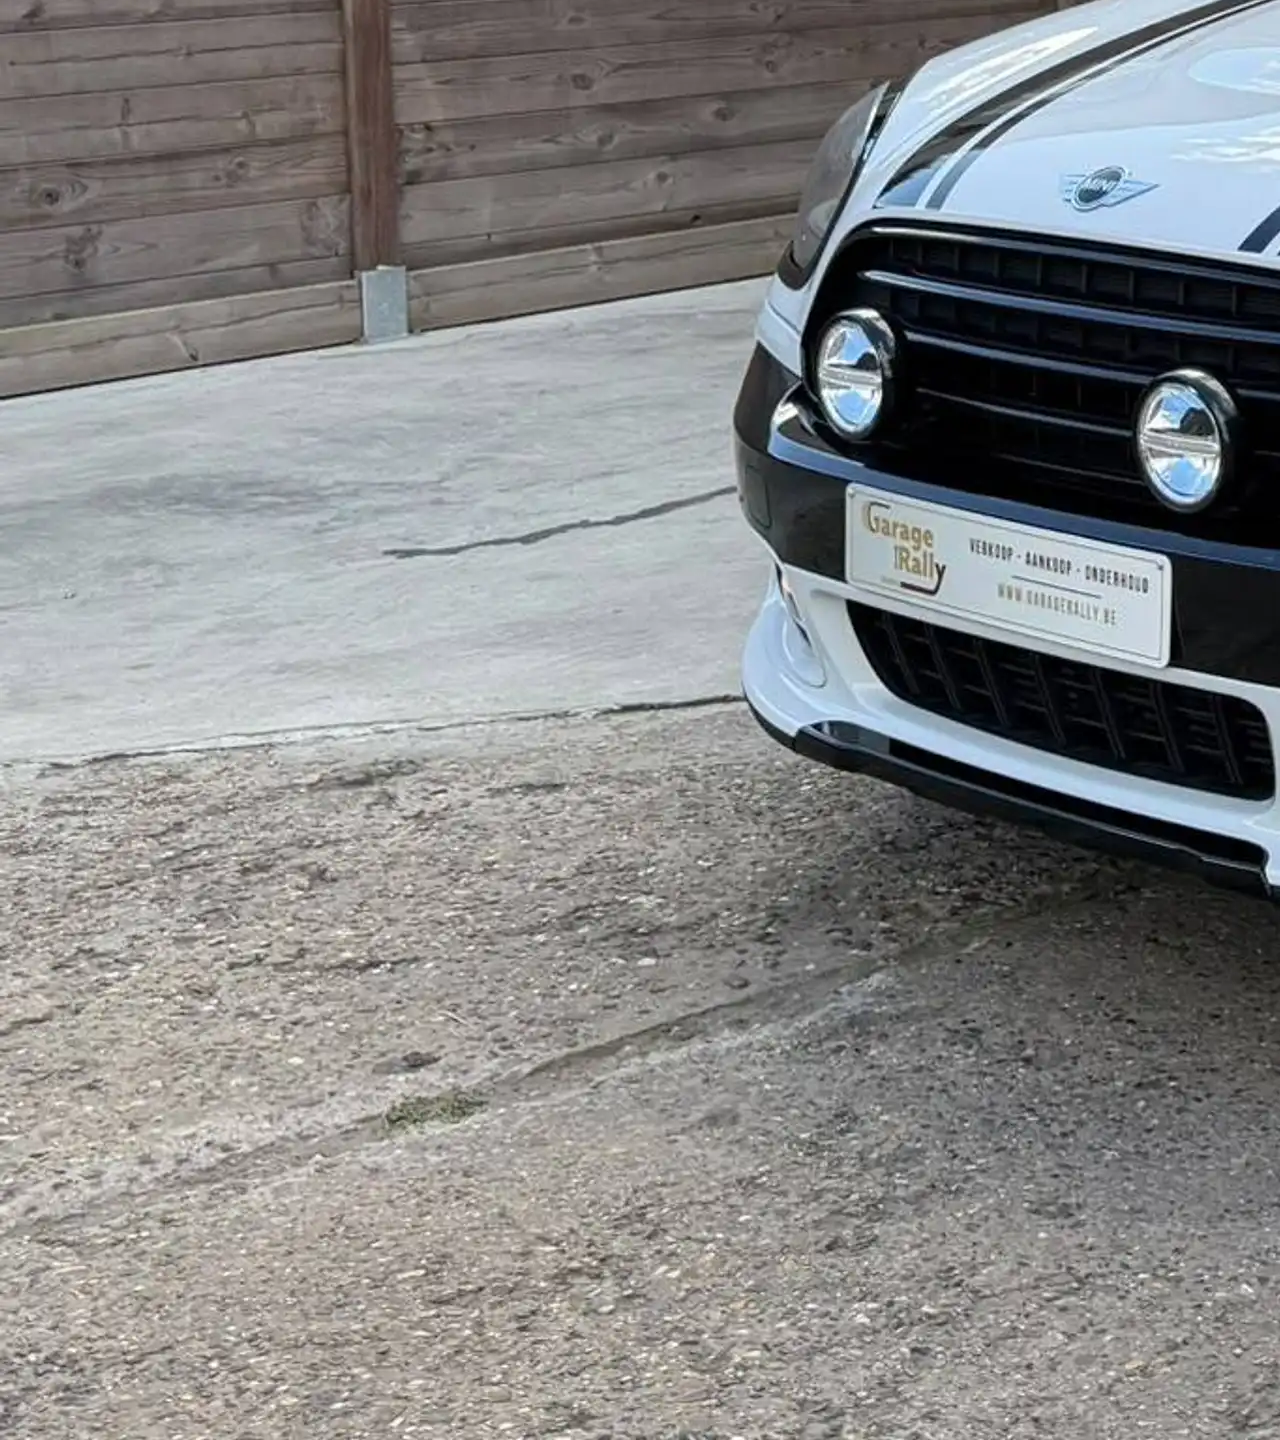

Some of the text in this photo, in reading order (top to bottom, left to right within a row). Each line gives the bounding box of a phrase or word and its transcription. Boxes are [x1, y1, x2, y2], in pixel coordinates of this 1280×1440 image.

[862, 501, 934, 551] Garage
[968, 538, 1014, 561] VERKOOP
[893, 546, 946, 596] Rally
